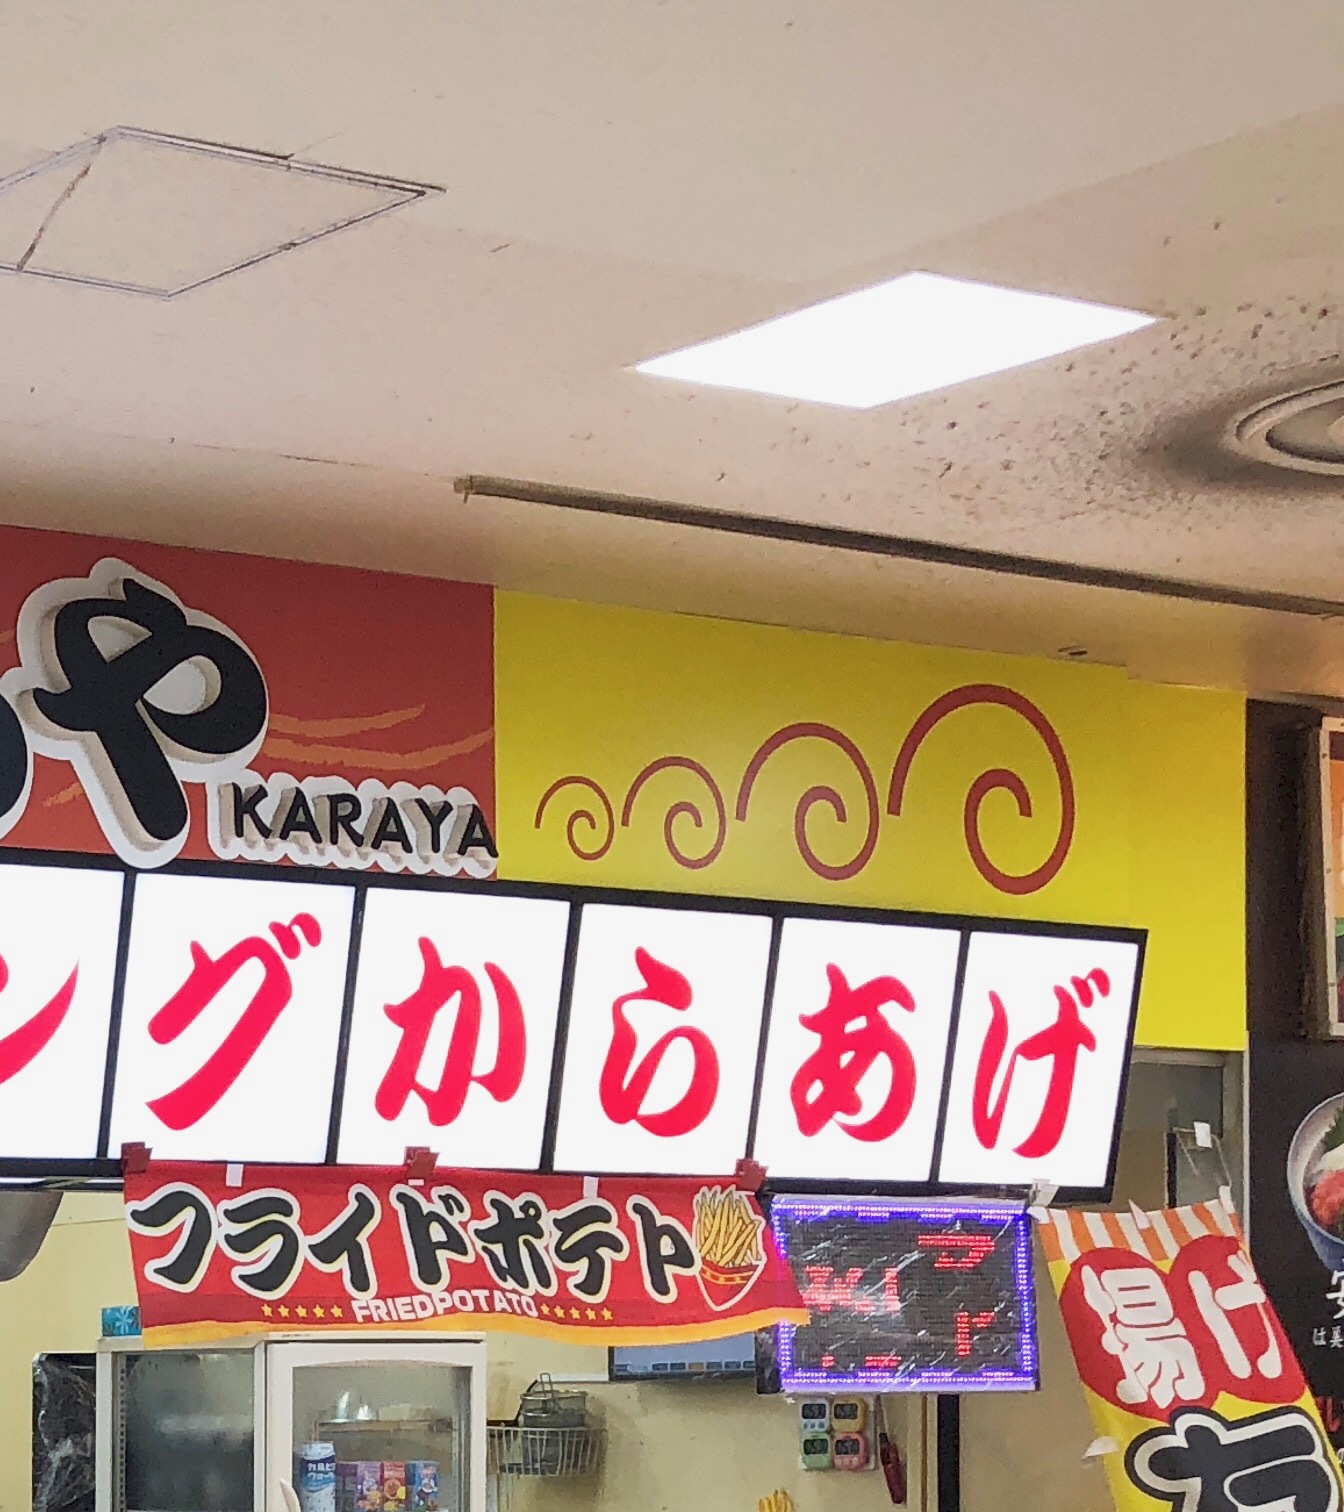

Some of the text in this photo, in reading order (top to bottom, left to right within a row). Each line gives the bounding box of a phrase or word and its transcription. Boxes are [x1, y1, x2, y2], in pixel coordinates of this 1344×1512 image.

[231, 781, 499, 859] KARAYA
[129, 1189, 696, 1298] フライドポテト
[352, 1288, 538, 1323] FRIEDPOTATO
[1084, 1250, 1285, 1410] 揚げ
